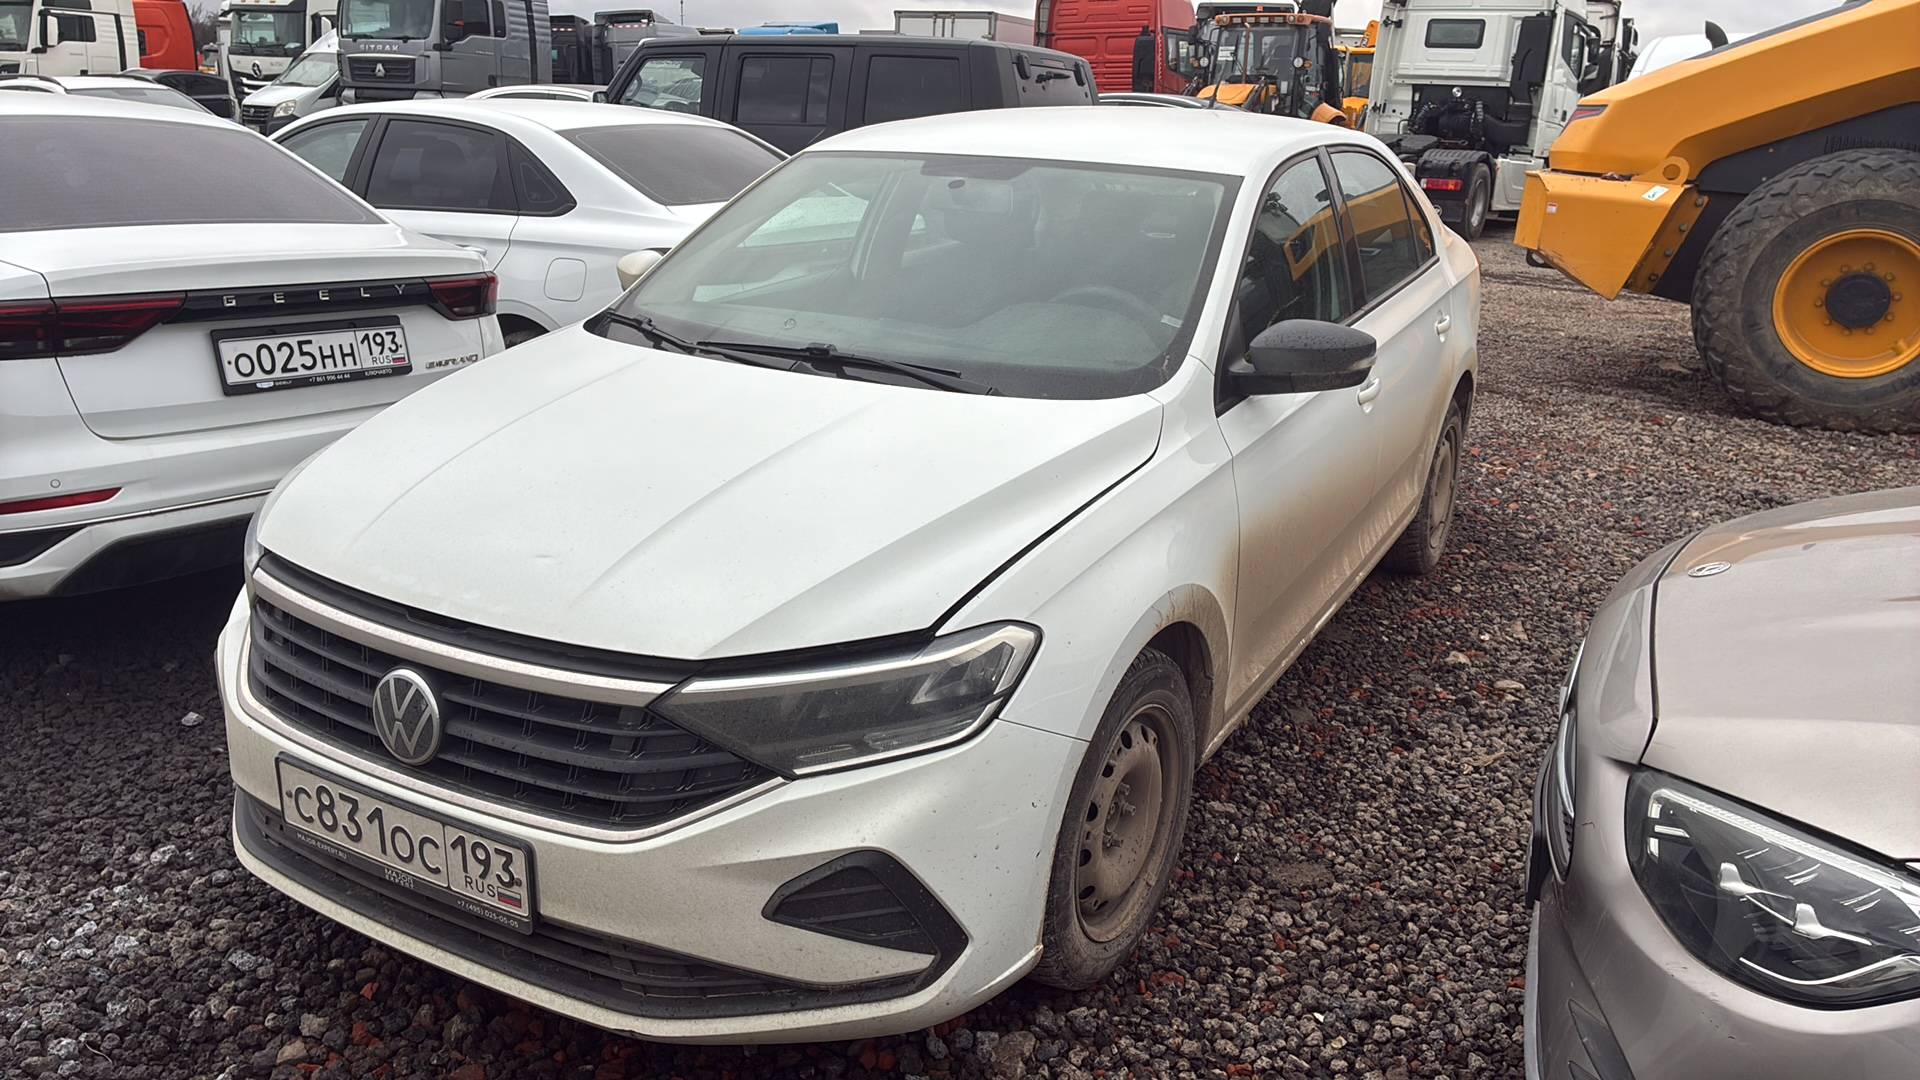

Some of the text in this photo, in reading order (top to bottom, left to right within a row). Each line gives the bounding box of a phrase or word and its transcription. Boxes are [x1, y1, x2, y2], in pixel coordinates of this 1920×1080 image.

[359, 43, 400, 52] SITRAK
[222, 284, 405, 307] GEELY
[360, 331, 400, 356] 193
[371, 355, 391, 366] RUS
[450, 834, 518, 889] 193
[384, 867, 414, 884] MAJOR
[464, 874, 496, 898] RUS
[465, 903, 484, 916] (495)
